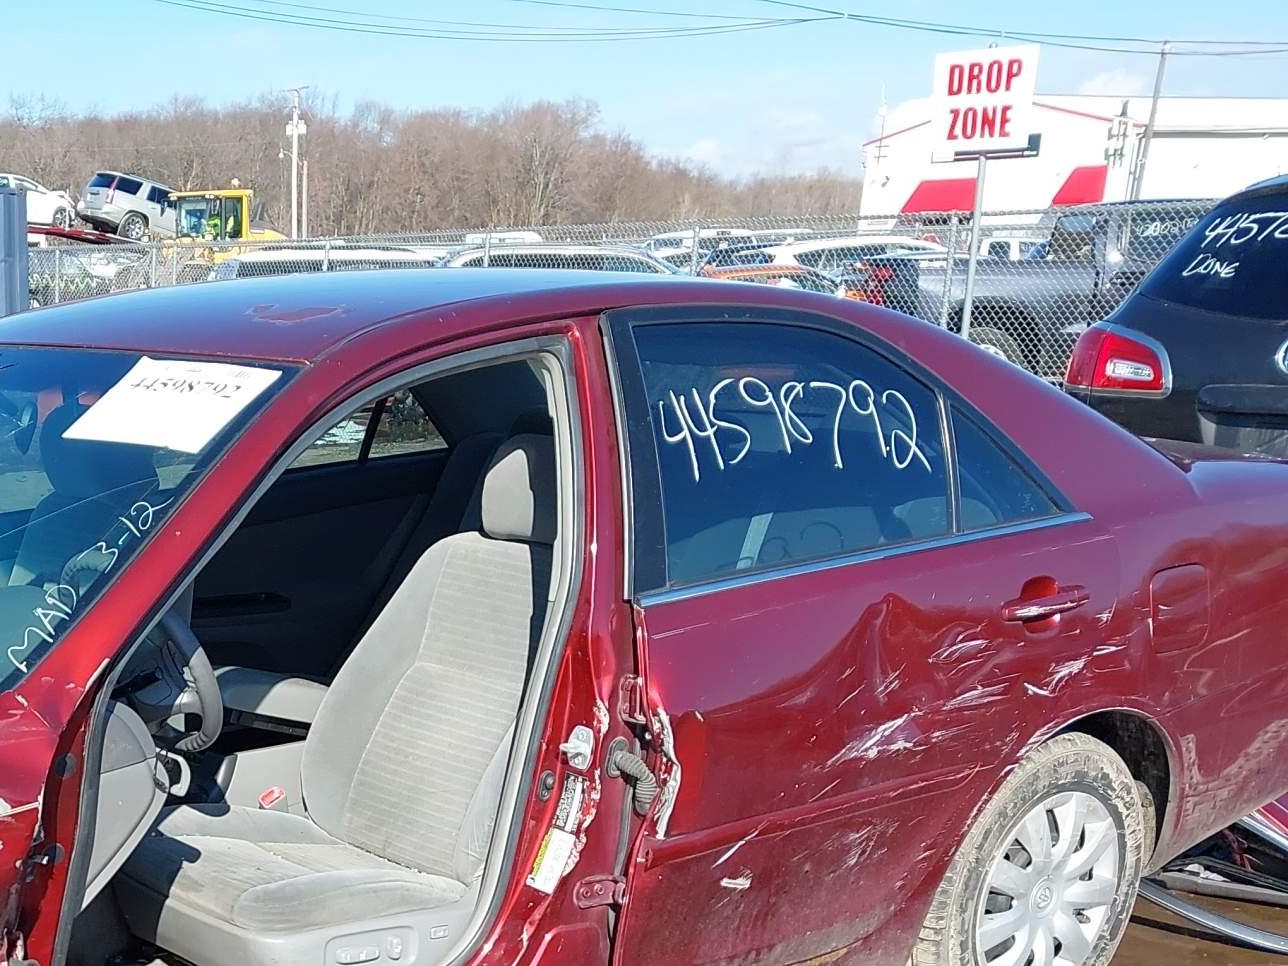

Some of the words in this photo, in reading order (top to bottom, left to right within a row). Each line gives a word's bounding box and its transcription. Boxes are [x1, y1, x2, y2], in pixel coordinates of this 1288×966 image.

[947, 57, 1023, 97] DROP
[946, 104, 1013, 141] ZONE
[1182, 253, 1241, 278] DONE
[130, 376, 243, 399] 44598792
[658, 376, 933, 483] 44598792
[7, 584, 78, 673] MAD
[76, 495, 176, 575] 3-12
